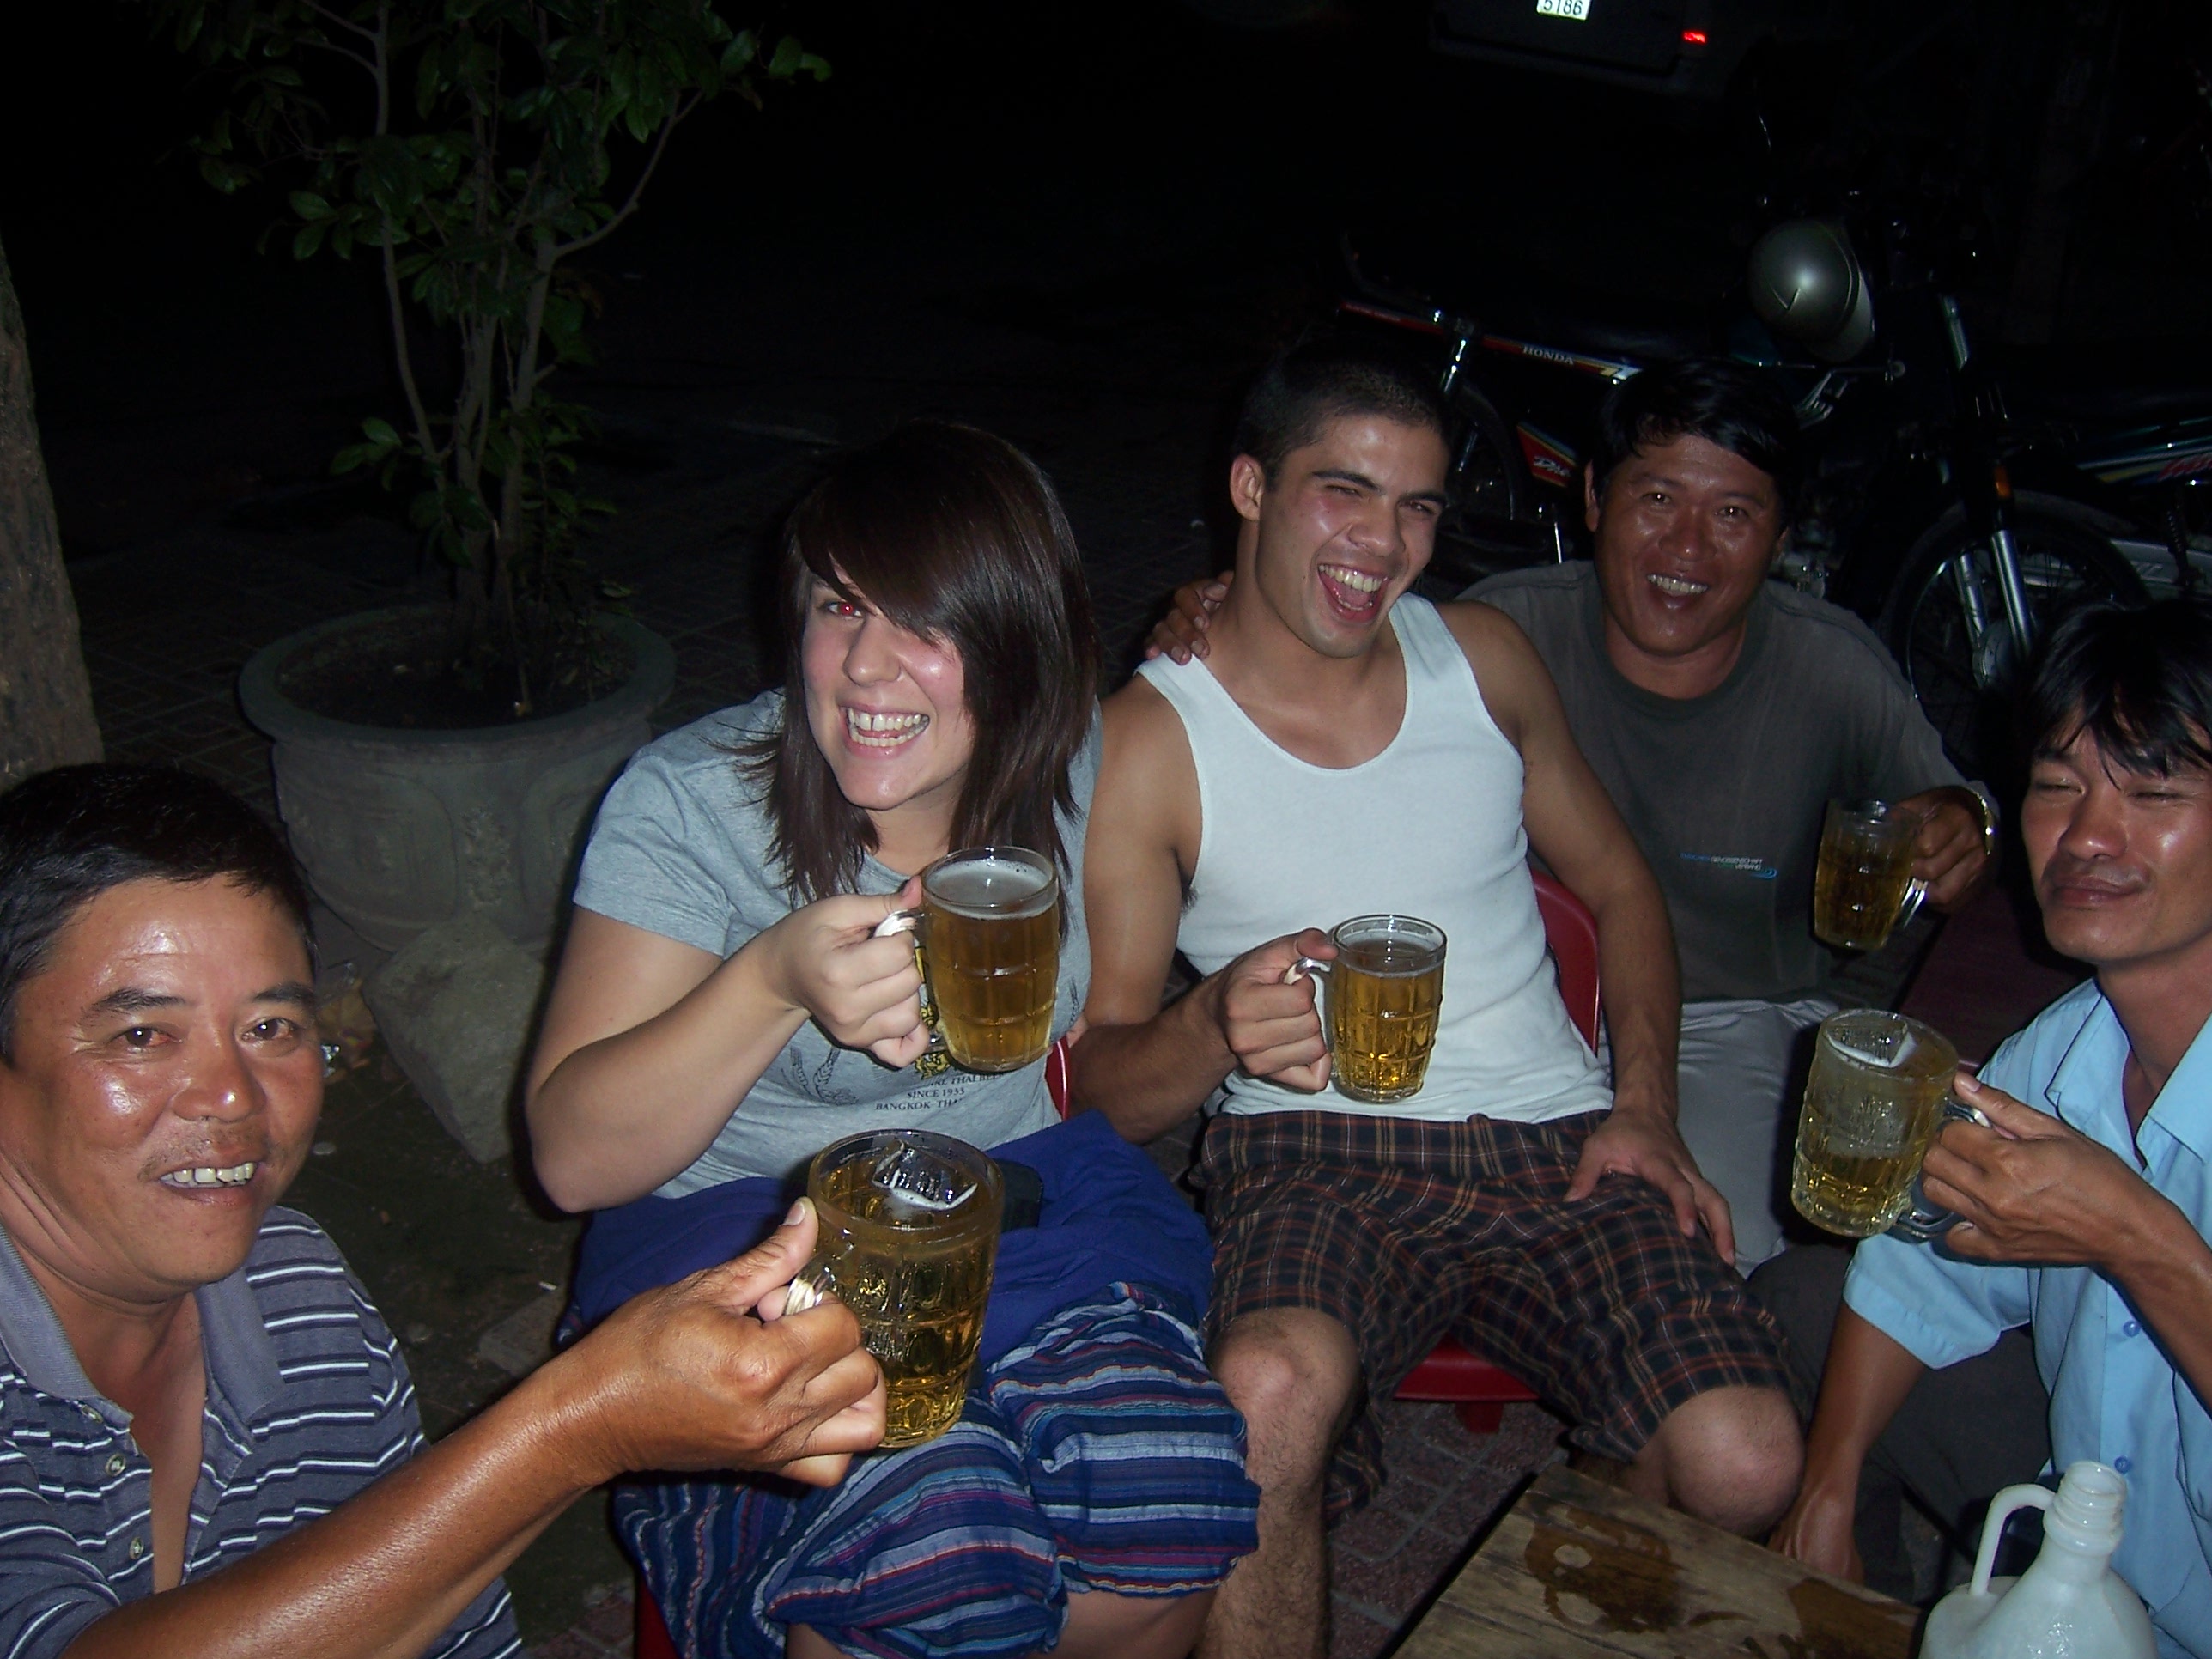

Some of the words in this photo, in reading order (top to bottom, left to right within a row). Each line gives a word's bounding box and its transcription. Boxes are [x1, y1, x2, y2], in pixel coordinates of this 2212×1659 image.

[1543, 0, 1583, 15] 5186
[1523, 344, 1574, 365] HONDA
[908, 1089, 939, 1098] SINCE
[875, 1101, 930, 1110] BANGKOK
